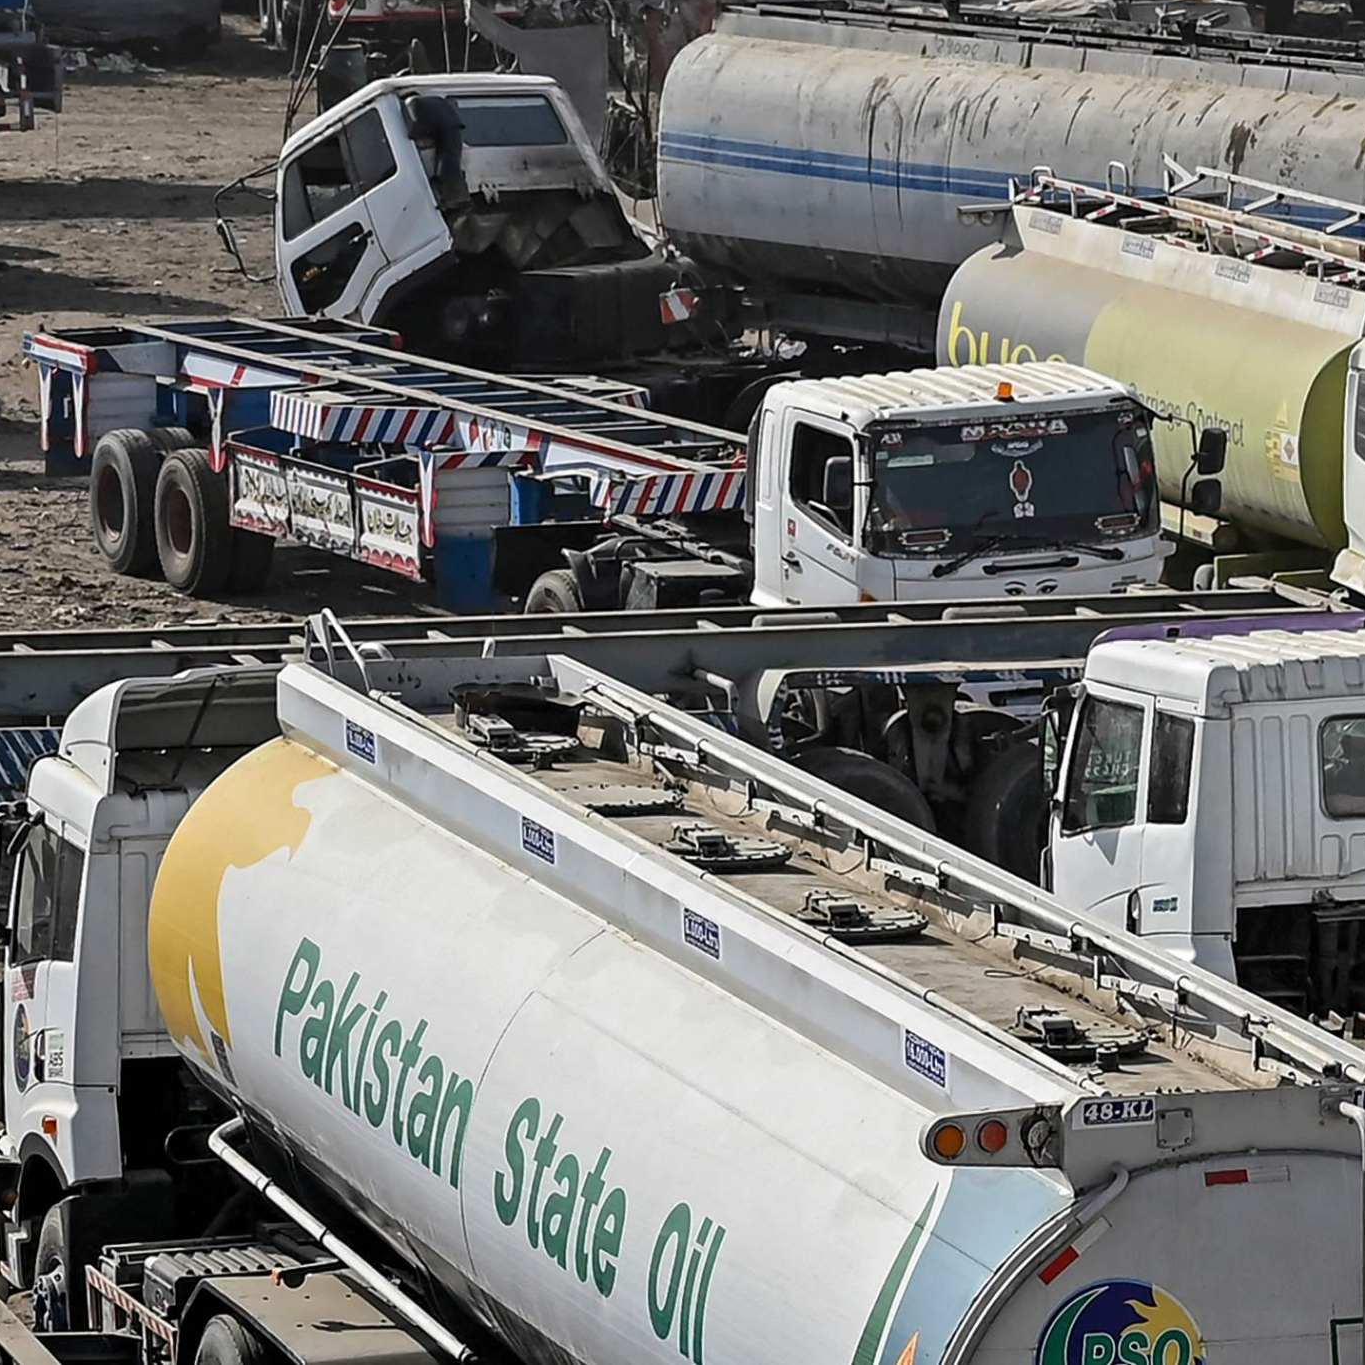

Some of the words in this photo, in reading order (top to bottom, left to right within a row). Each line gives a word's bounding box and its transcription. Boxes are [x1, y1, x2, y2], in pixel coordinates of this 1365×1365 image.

[273, 936, 476, 1191] Pakistan
[493, 1096, 630, 1299] State
[647, 1201, 727, 1365] Oil
